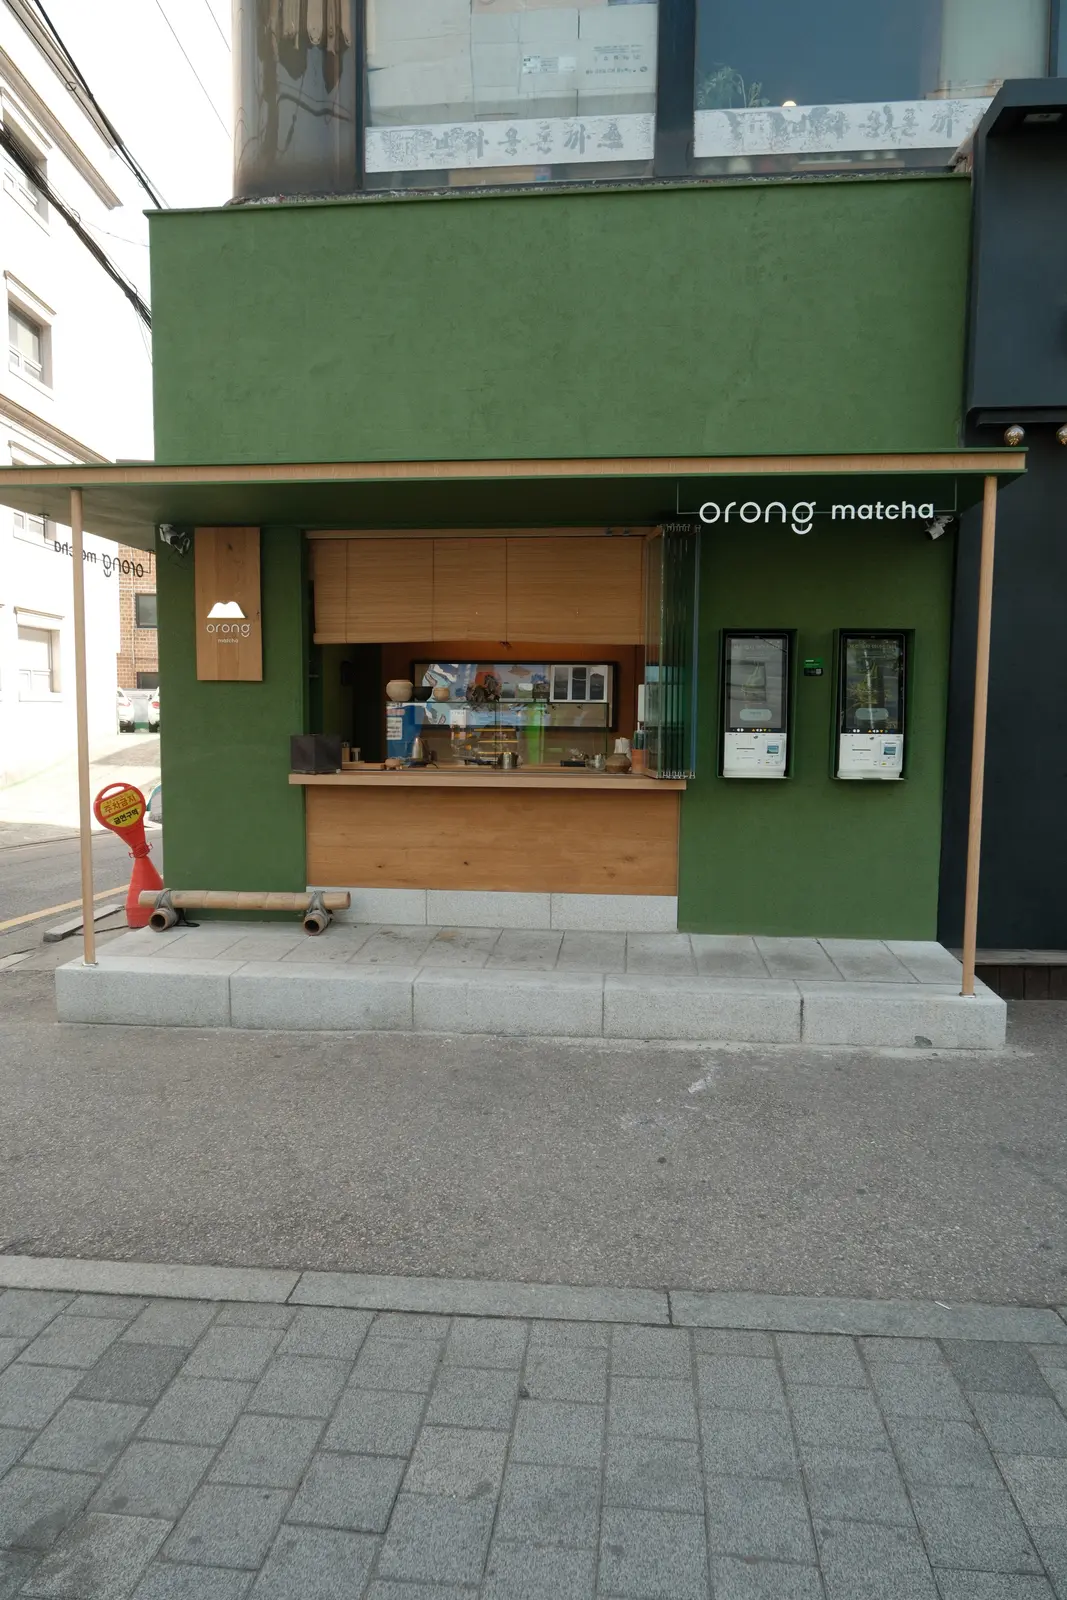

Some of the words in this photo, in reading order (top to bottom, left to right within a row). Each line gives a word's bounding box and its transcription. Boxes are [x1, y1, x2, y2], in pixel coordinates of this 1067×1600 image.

[699, 501, 816, 535] orong
[831, 501, 934, 520] matcha
[206, 623, 251, 638] orong
[104, 795, 136, 813] 주차금지
[114, 809, 139, 825] 금연구역
